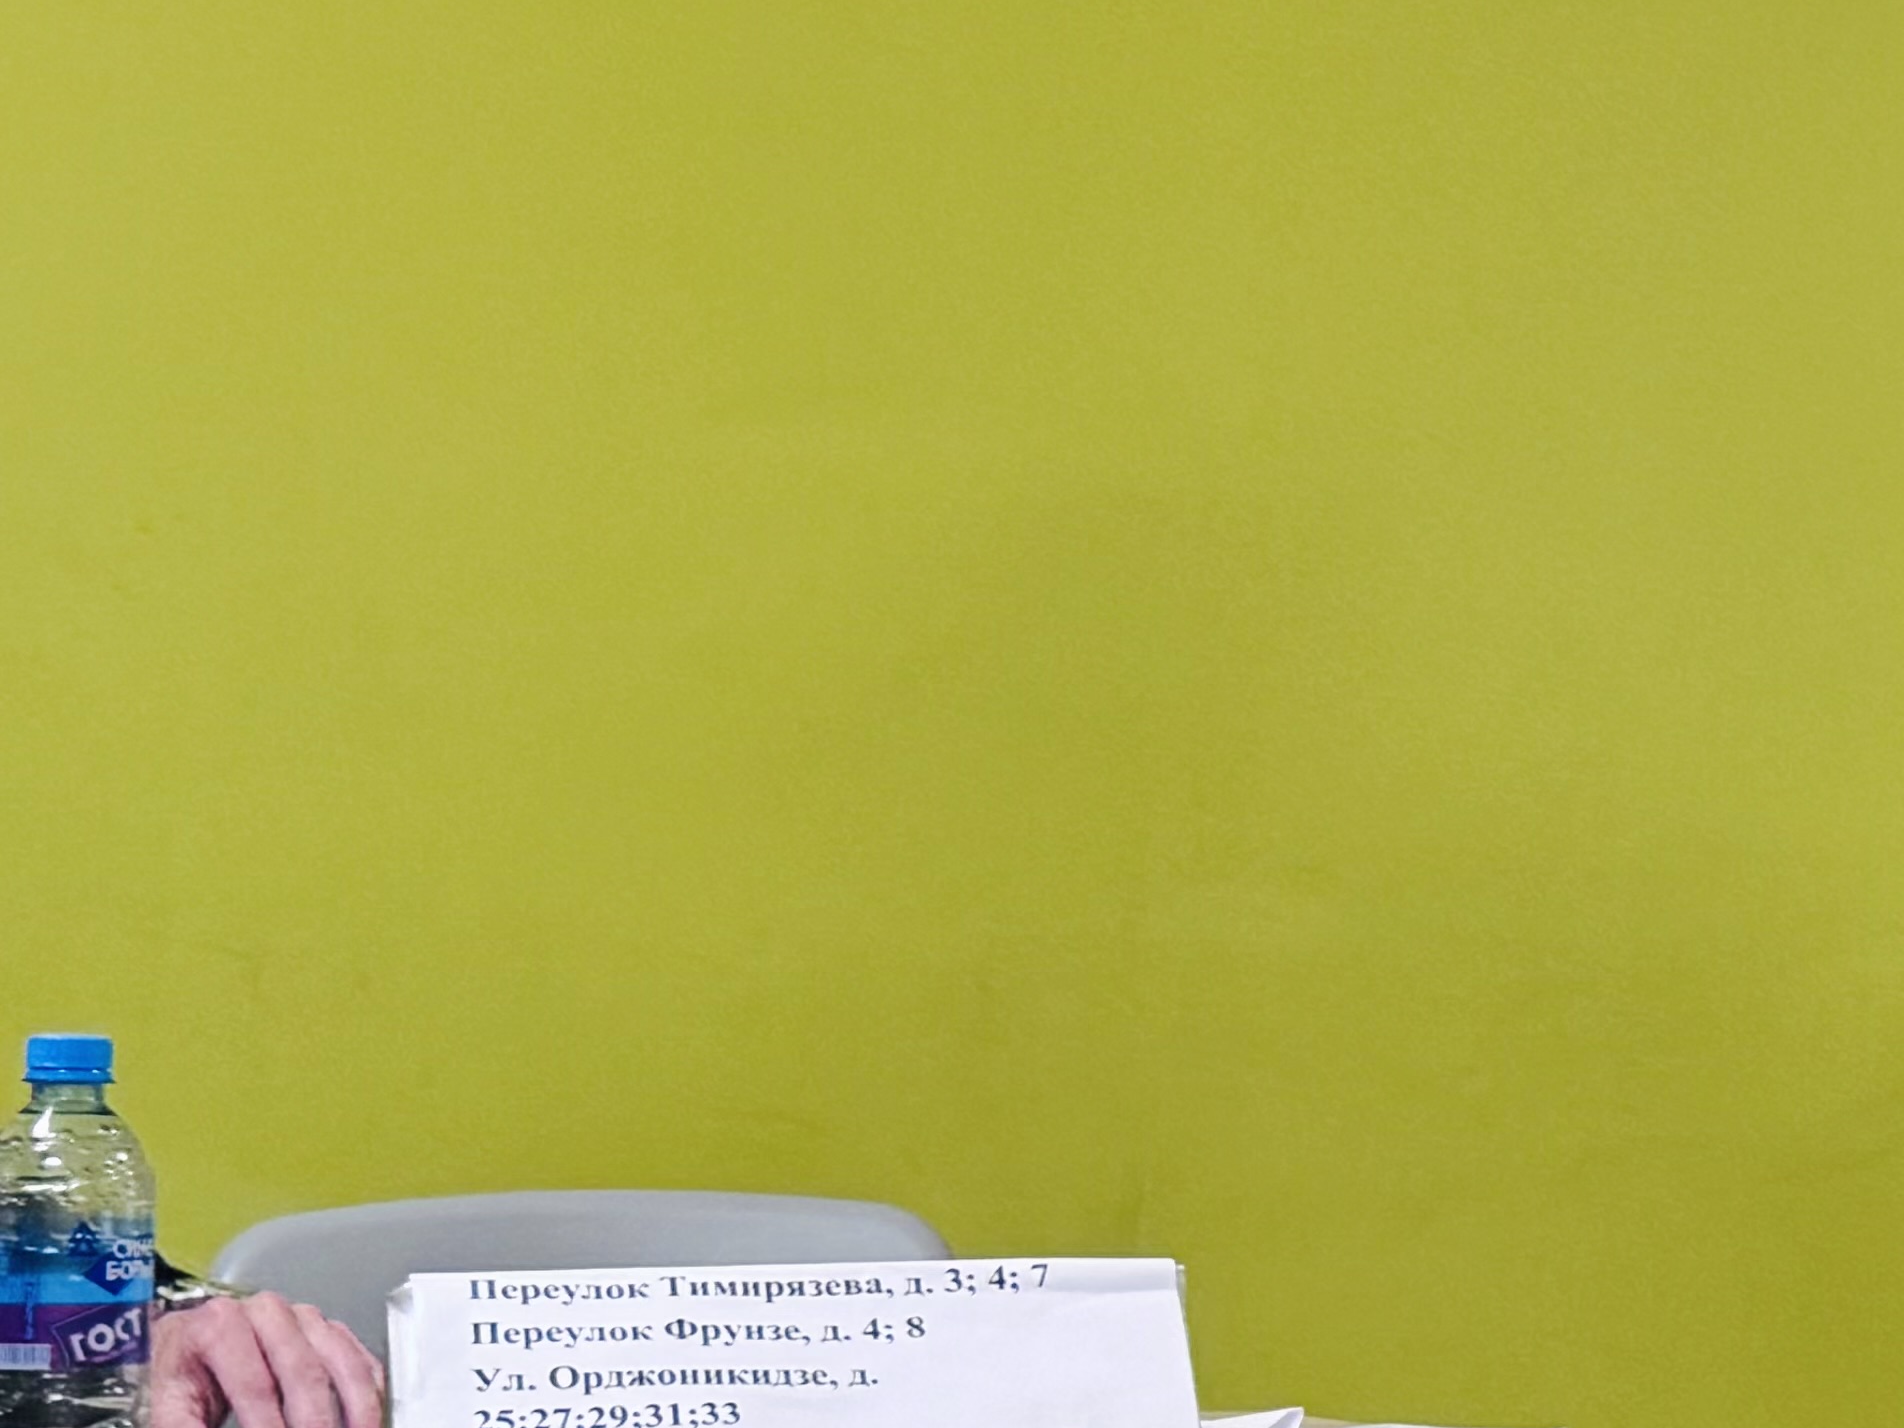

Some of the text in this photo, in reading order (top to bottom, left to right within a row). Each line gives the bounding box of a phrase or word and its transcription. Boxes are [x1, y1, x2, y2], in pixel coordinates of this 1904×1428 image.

[469, 1263, 1049, 1305] Переулок Тимирязева, д. 3; 4; 7
[69, 1307, 142, 1362] ГОСТ
[471, 1316, 926, 1350] Переулок Фрунзе, д. 4; 8
[471, 1365, 878, 1395] Ул. Орджоникидзе, д.
